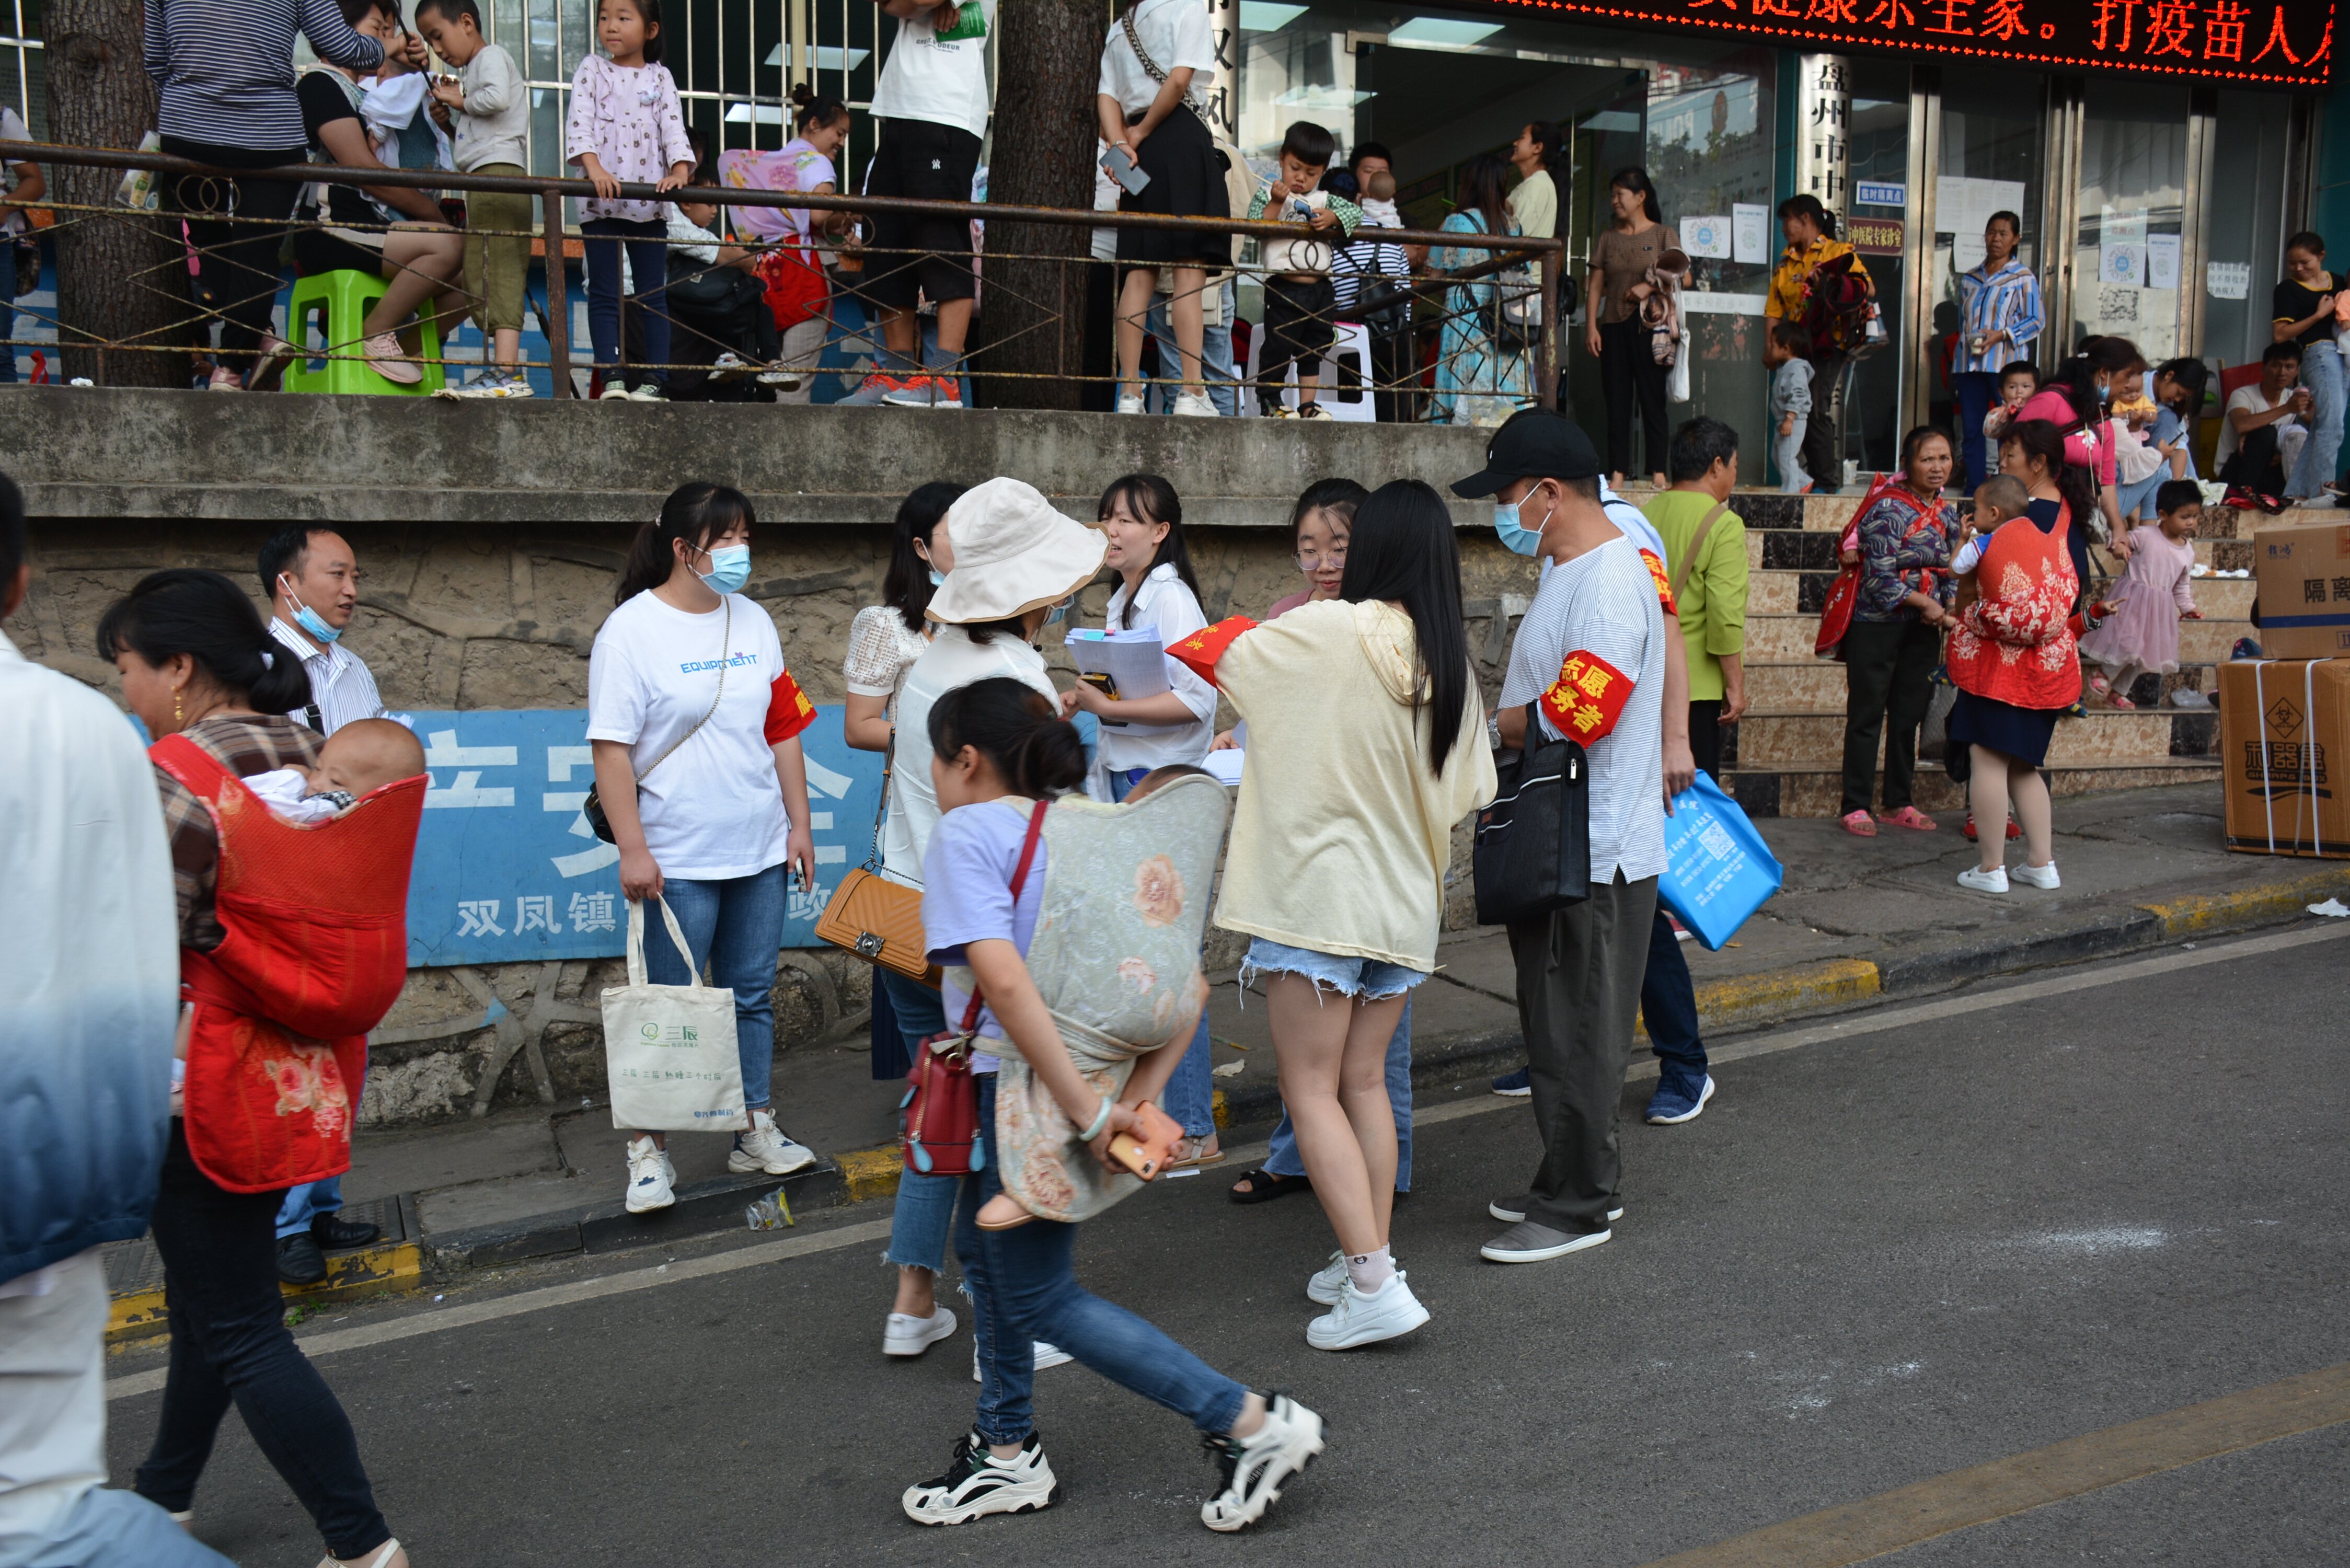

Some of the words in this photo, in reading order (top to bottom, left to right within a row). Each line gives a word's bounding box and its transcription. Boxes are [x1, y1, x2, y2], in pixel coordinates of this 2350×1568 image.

[1811, 62, 1849, 236] 盘州市中
[1861, 187, 1902, 202] 临时隔离点
[680, 655, 757, 674] EQUIPMENT
[2248, 771, 2296, 780] SHRPS
[665, 1025, 698, 1041] 三辰
